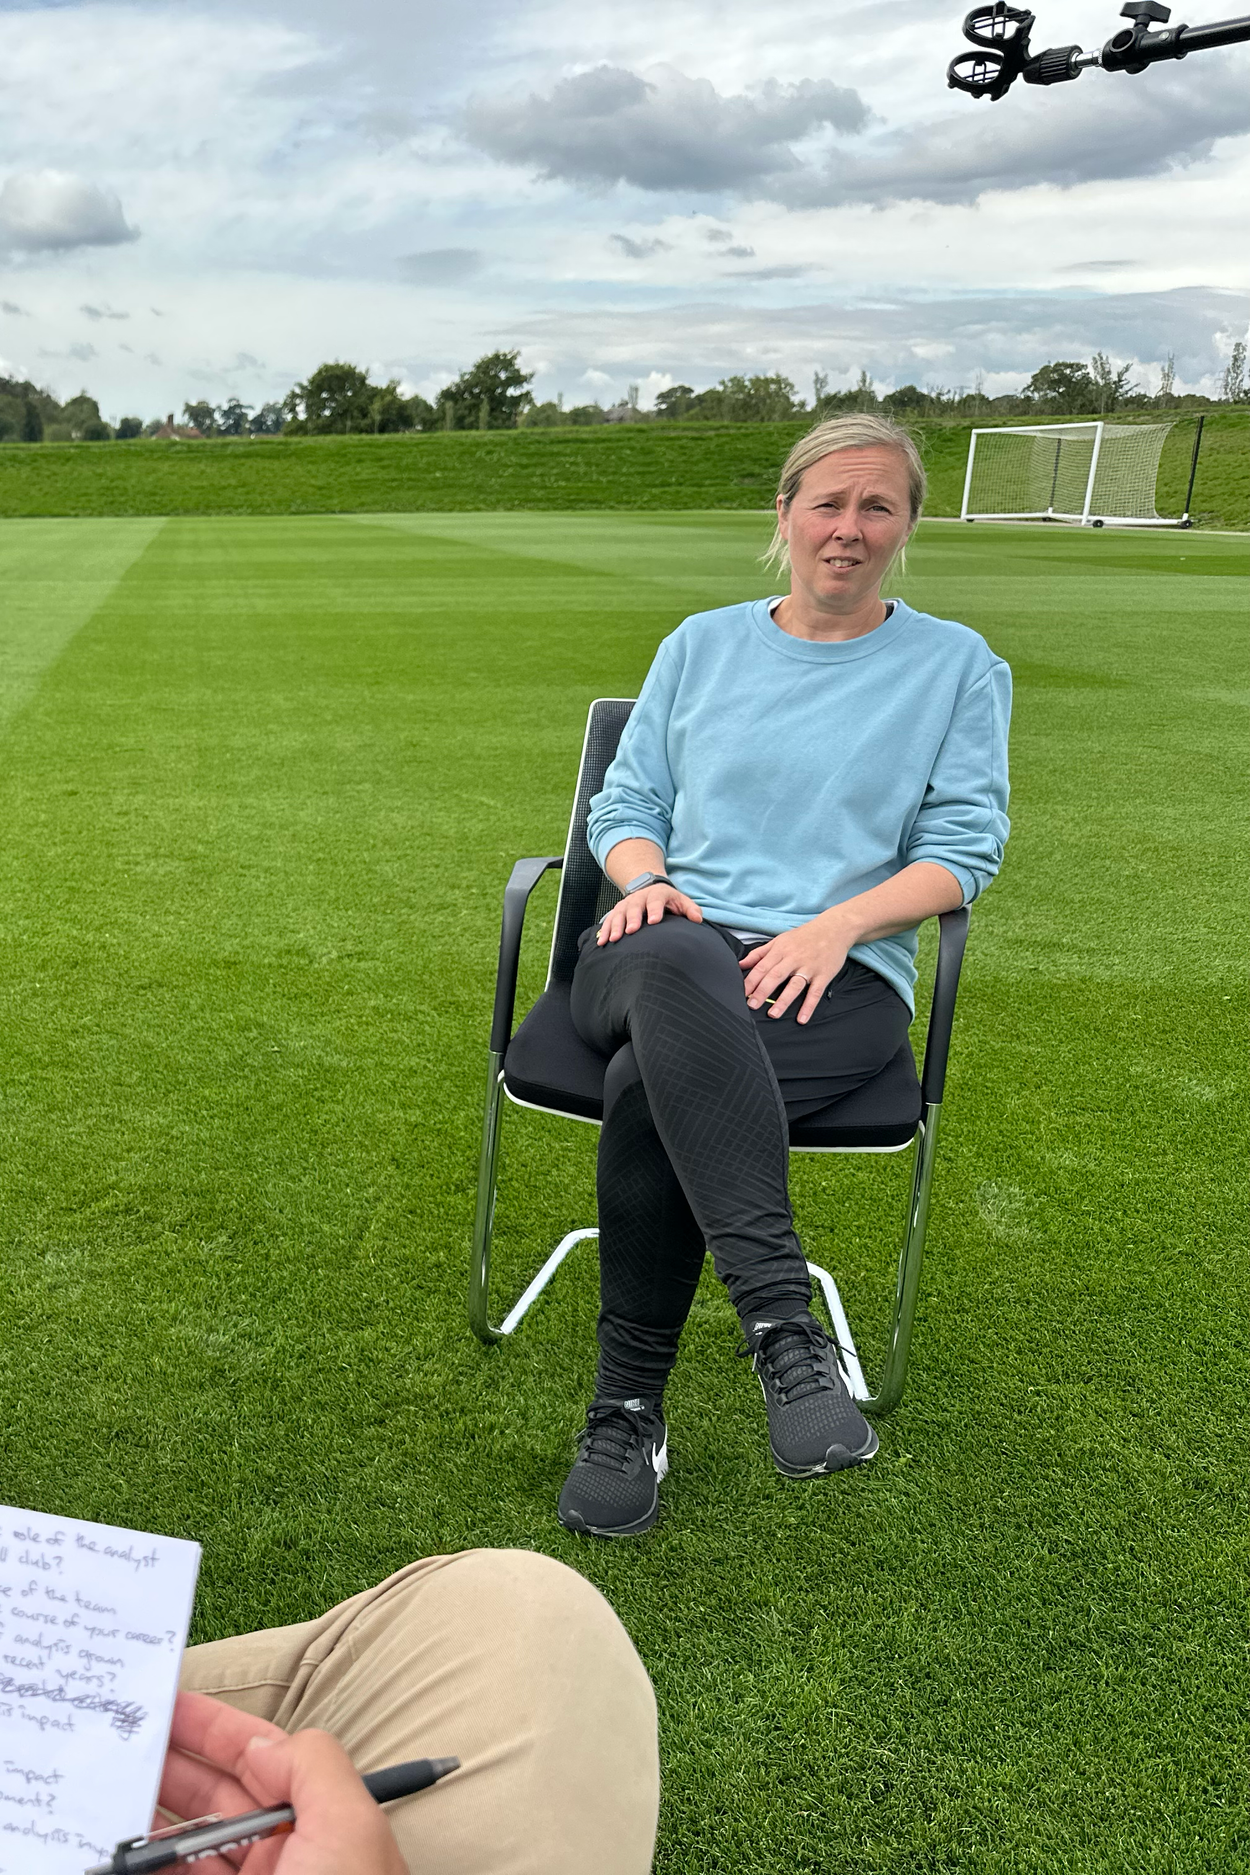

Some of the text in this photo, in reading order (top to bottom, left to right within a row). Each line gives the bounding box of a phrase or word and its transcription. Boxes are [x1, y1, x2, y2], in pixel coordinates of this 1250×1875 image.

[18, 1550, 64, 1575] club?
[46, 1530, 66, 1546] of
[75, 1533, 100, 1552] the
[104, 1544, 160, 1573] analyst
[21, 1580, 38, 1597] of
[45, 1586, 68, 1603] the
[75, 1590, 117, 1615] team
[11, 1606, 59, 1626] course
[63, 1613, 81, 1628] of
[84, 1624, 120, 1639] your
[125, 1630, 176, 1652] career?
[14, 1631, 72, 1660] analysis
[78, 1649, 125, 1671] grown
[3, 1654, 45, 1671] recent
[55, 1668, 116, 1693] years?
[18, 1704, 76, 1732] impact
[3, 1760, 65, 1785] impact
[3, 1819, 69, 1845] analysis
